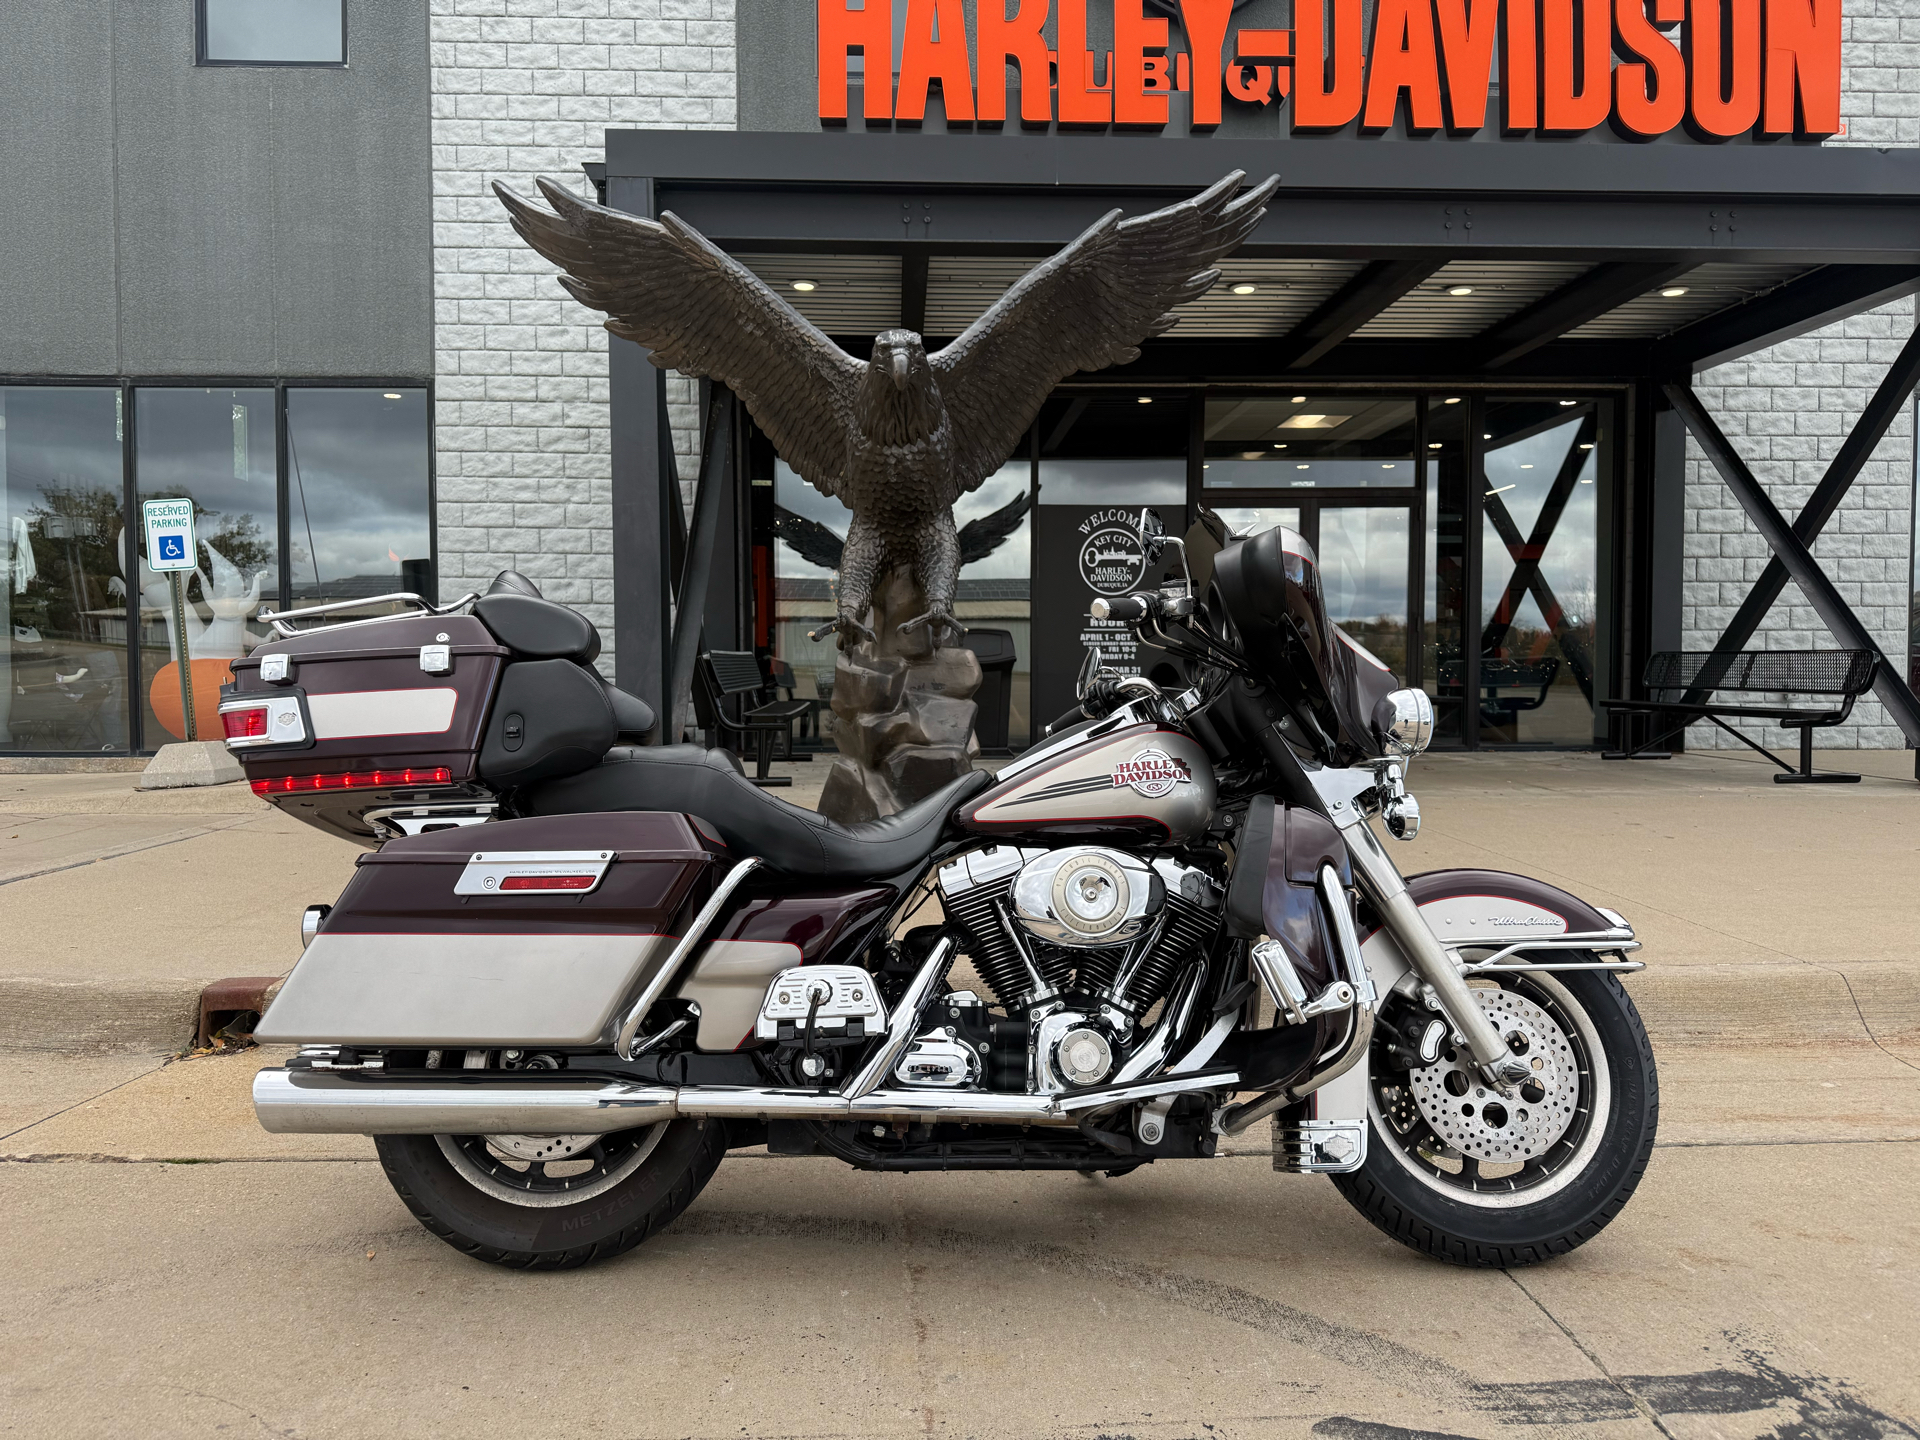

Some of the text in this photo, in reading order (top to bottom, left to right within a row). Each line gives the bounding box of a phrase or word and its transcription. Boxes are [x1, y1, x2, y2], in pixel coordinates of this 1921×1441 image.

[818, 0, 1841, 136] HARLEY-DAVIDSON
[147, 506, 189, 517] RESERVED
[151, 518, 187, 528] PARKING
[1093, 534, 1133, 547] KEY CITY
[1095, 567, 1131, 575] HARLEY-
[1090, 574, 1132, 582] DAVIDSON
[1090, 618, 1127, 627] HOUR
[1080, 633, 1104, 641] APRIL
[1104, 633, 1109, 641] 1
[1115, 633, 1131, 641] OCT
[1131, 666, 1141, 674] 31
[1118, 758, 1185, 773] HARLEY
[1113, 768, 1191, 786] DAVIDSON
[1524, 916, 1564, 926] Classic
[561, 1166, 662, 1232] METZELER
